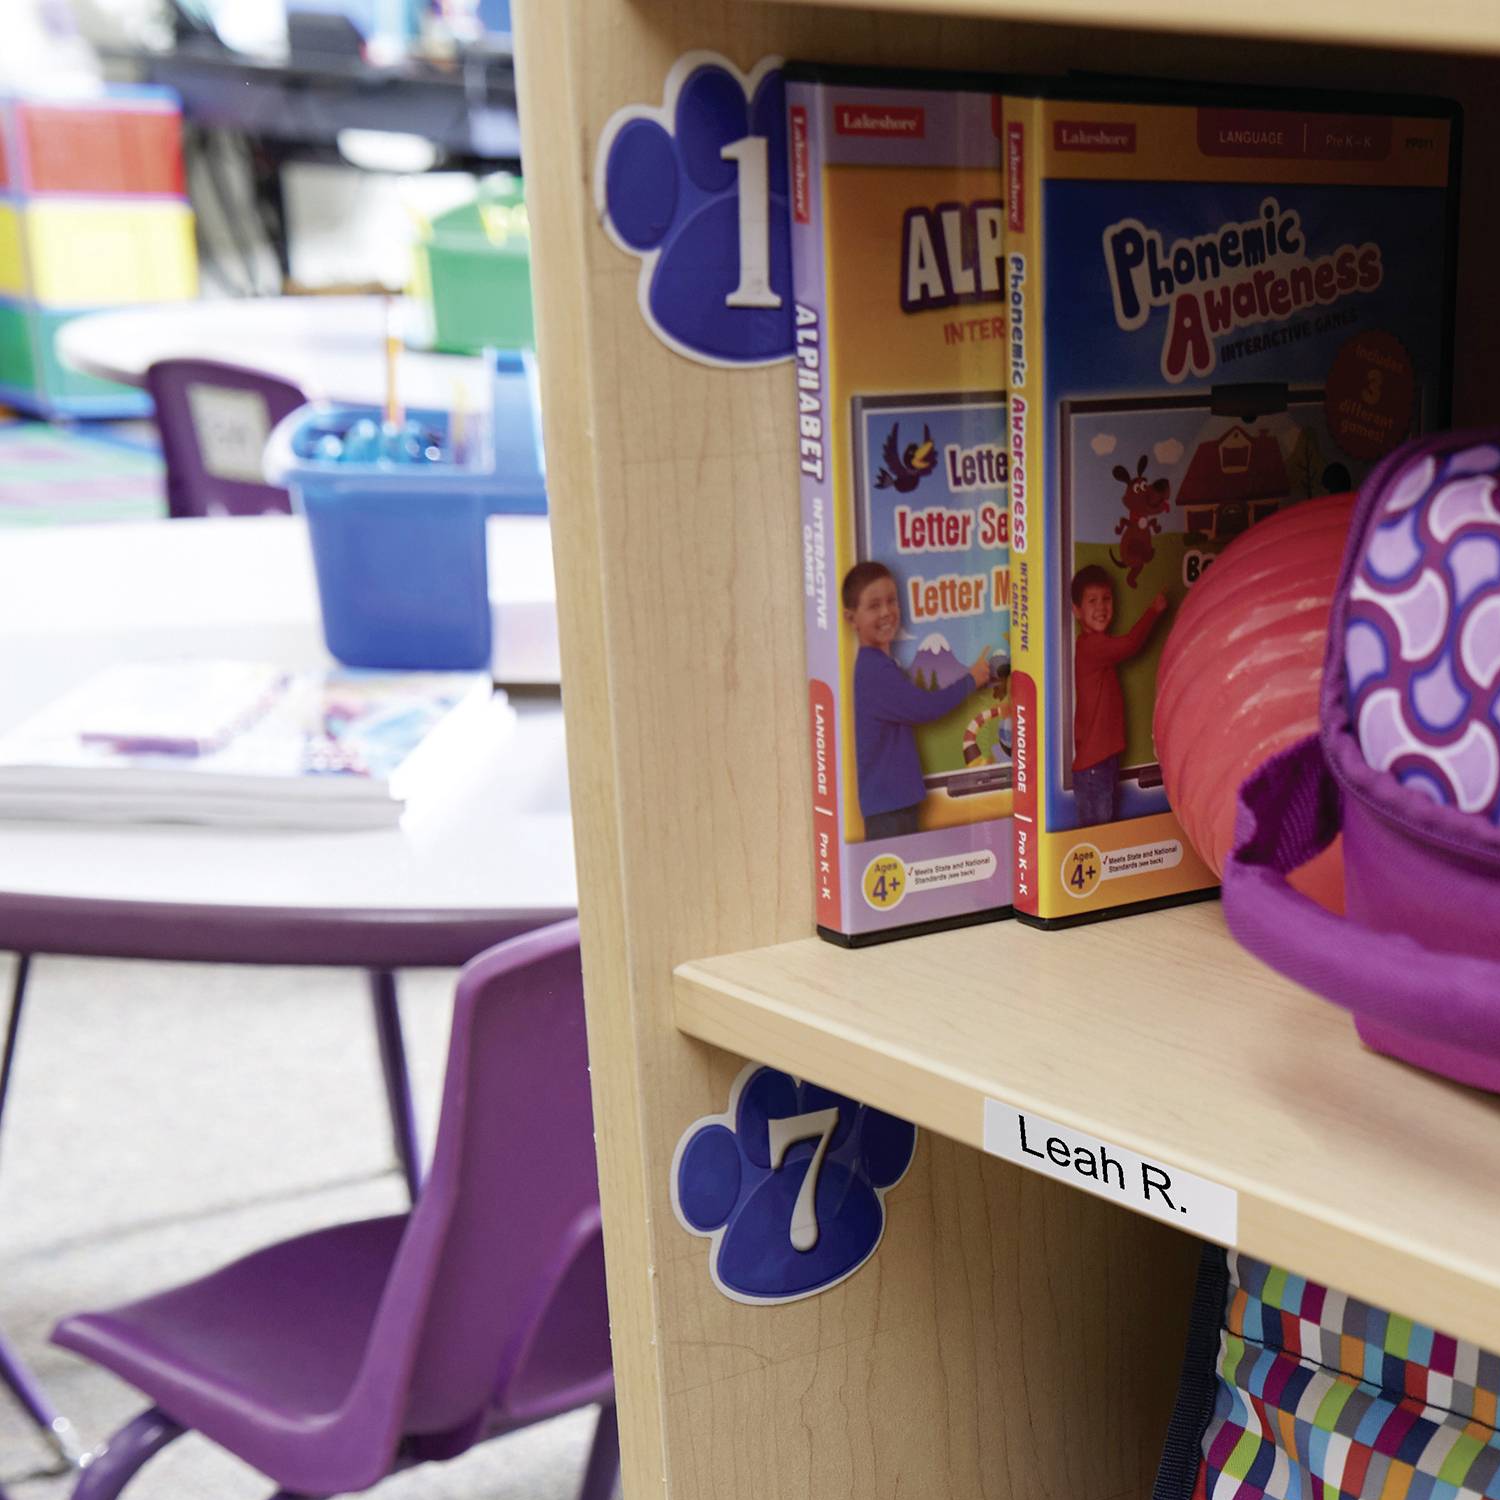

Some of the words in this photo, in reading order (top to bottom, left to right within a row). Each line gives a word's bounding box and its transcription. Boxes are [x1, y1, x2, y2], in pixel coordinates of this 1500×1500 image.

[844, 112, 916, 130] Lakeshore
[1219, 130, 1284, 145] LANGUAGE
[721, 136, 782, 308] 1
[1108, 201, 1302, 322] Phonemic
[1010, 255, 1025, 386] Phonemic
[1163, 246, 1382, 380] Awareness
[1221, 322, 1310, 363] INTERACTIVE
[795, 303, 823, 482] ALPHABET
[1011, 397, 1026, 550] Awareness
[898, 511, 970, 548] Letter
[911, 579, 983, 618] Letter
[814, 703, 827, 795] LANGUAGE
[1016, 705, 1027, 793] LANGUAGE
[874, 863, 898, 874] Ages
[1018, 830, 1027, 855] Pre
[1073, 851, 1094, 862] Ages
[872, 875, 900, 902] 4+
[1071, 864, 1096, 889] 4+
[768, 1107, 839, 1252] 7
[1017, 1114, 1126, 1191] Leah
[1142, 1162, 1188, 1214] R.
